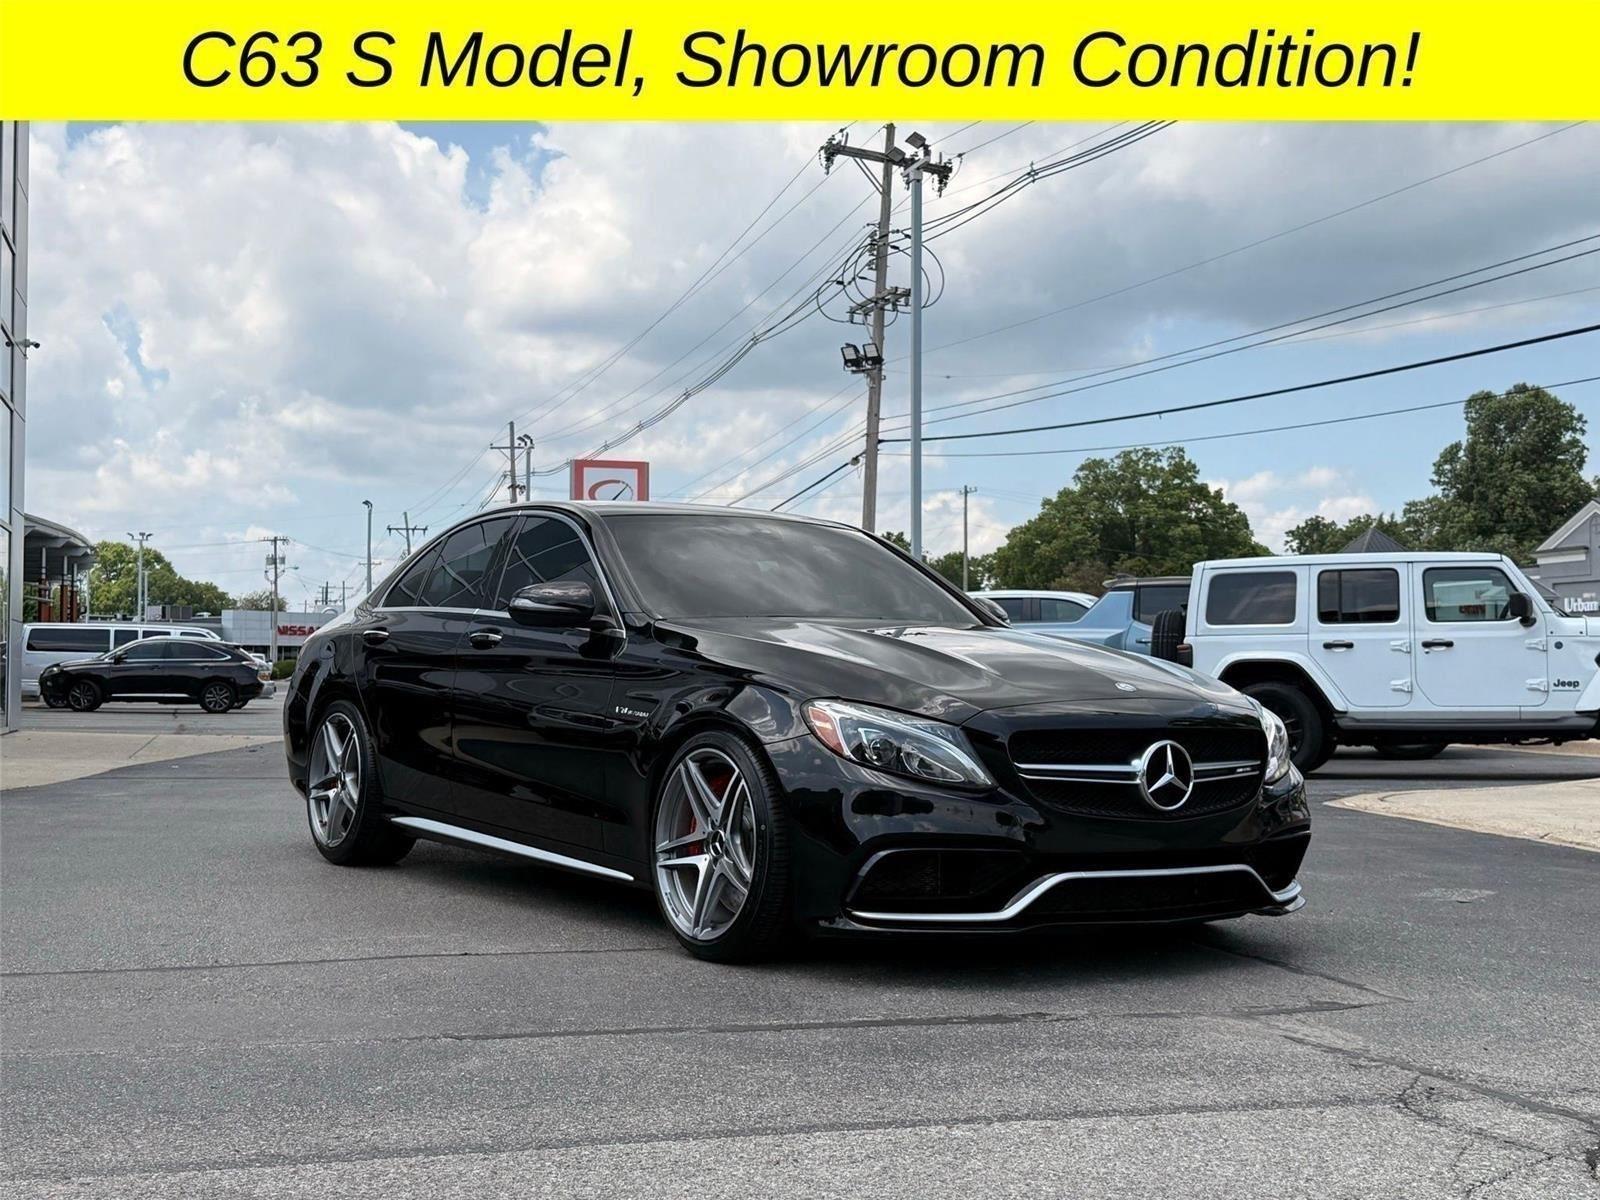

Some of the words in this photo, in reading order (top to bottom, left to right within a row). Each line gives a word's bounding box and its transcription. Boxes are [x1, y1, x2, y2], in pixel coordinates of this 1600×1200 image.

[1564, 597, 1599, 612] Urban
[277, 625, 320, 636] NISSA
[1553, 679, 1580, 688] Jeep
